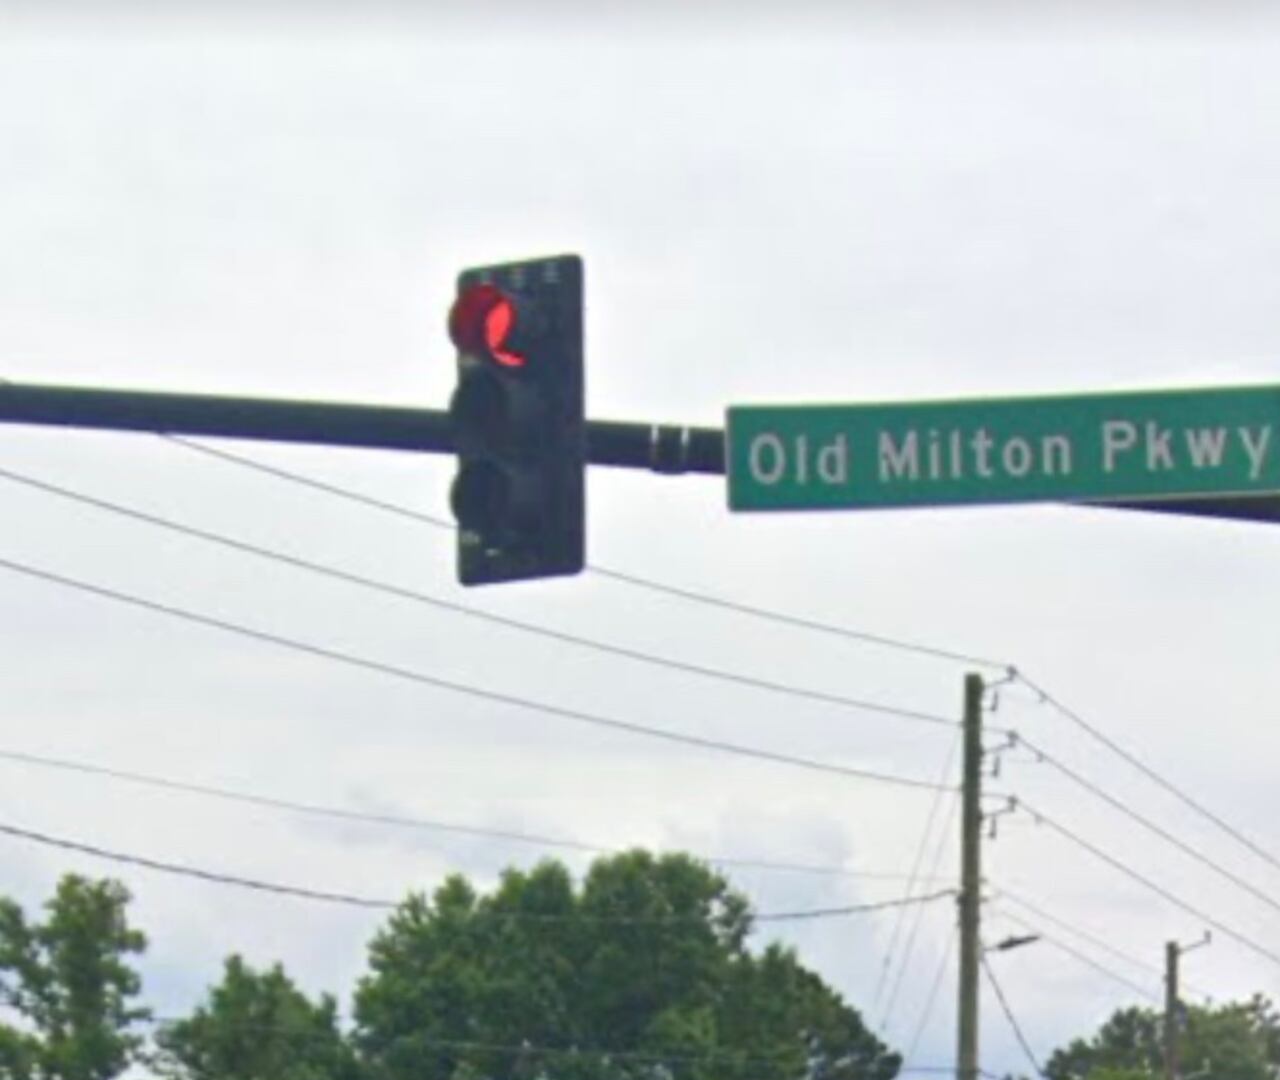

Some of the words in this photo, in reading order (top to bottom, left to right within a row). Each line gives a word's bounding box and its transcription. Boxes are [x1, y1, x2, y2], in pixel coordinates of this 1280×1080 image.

[749, 432, 847, 485] Old
[879, 428, 1072, 481] Milton
[1102, 419, 1272, 478] Pkwy
